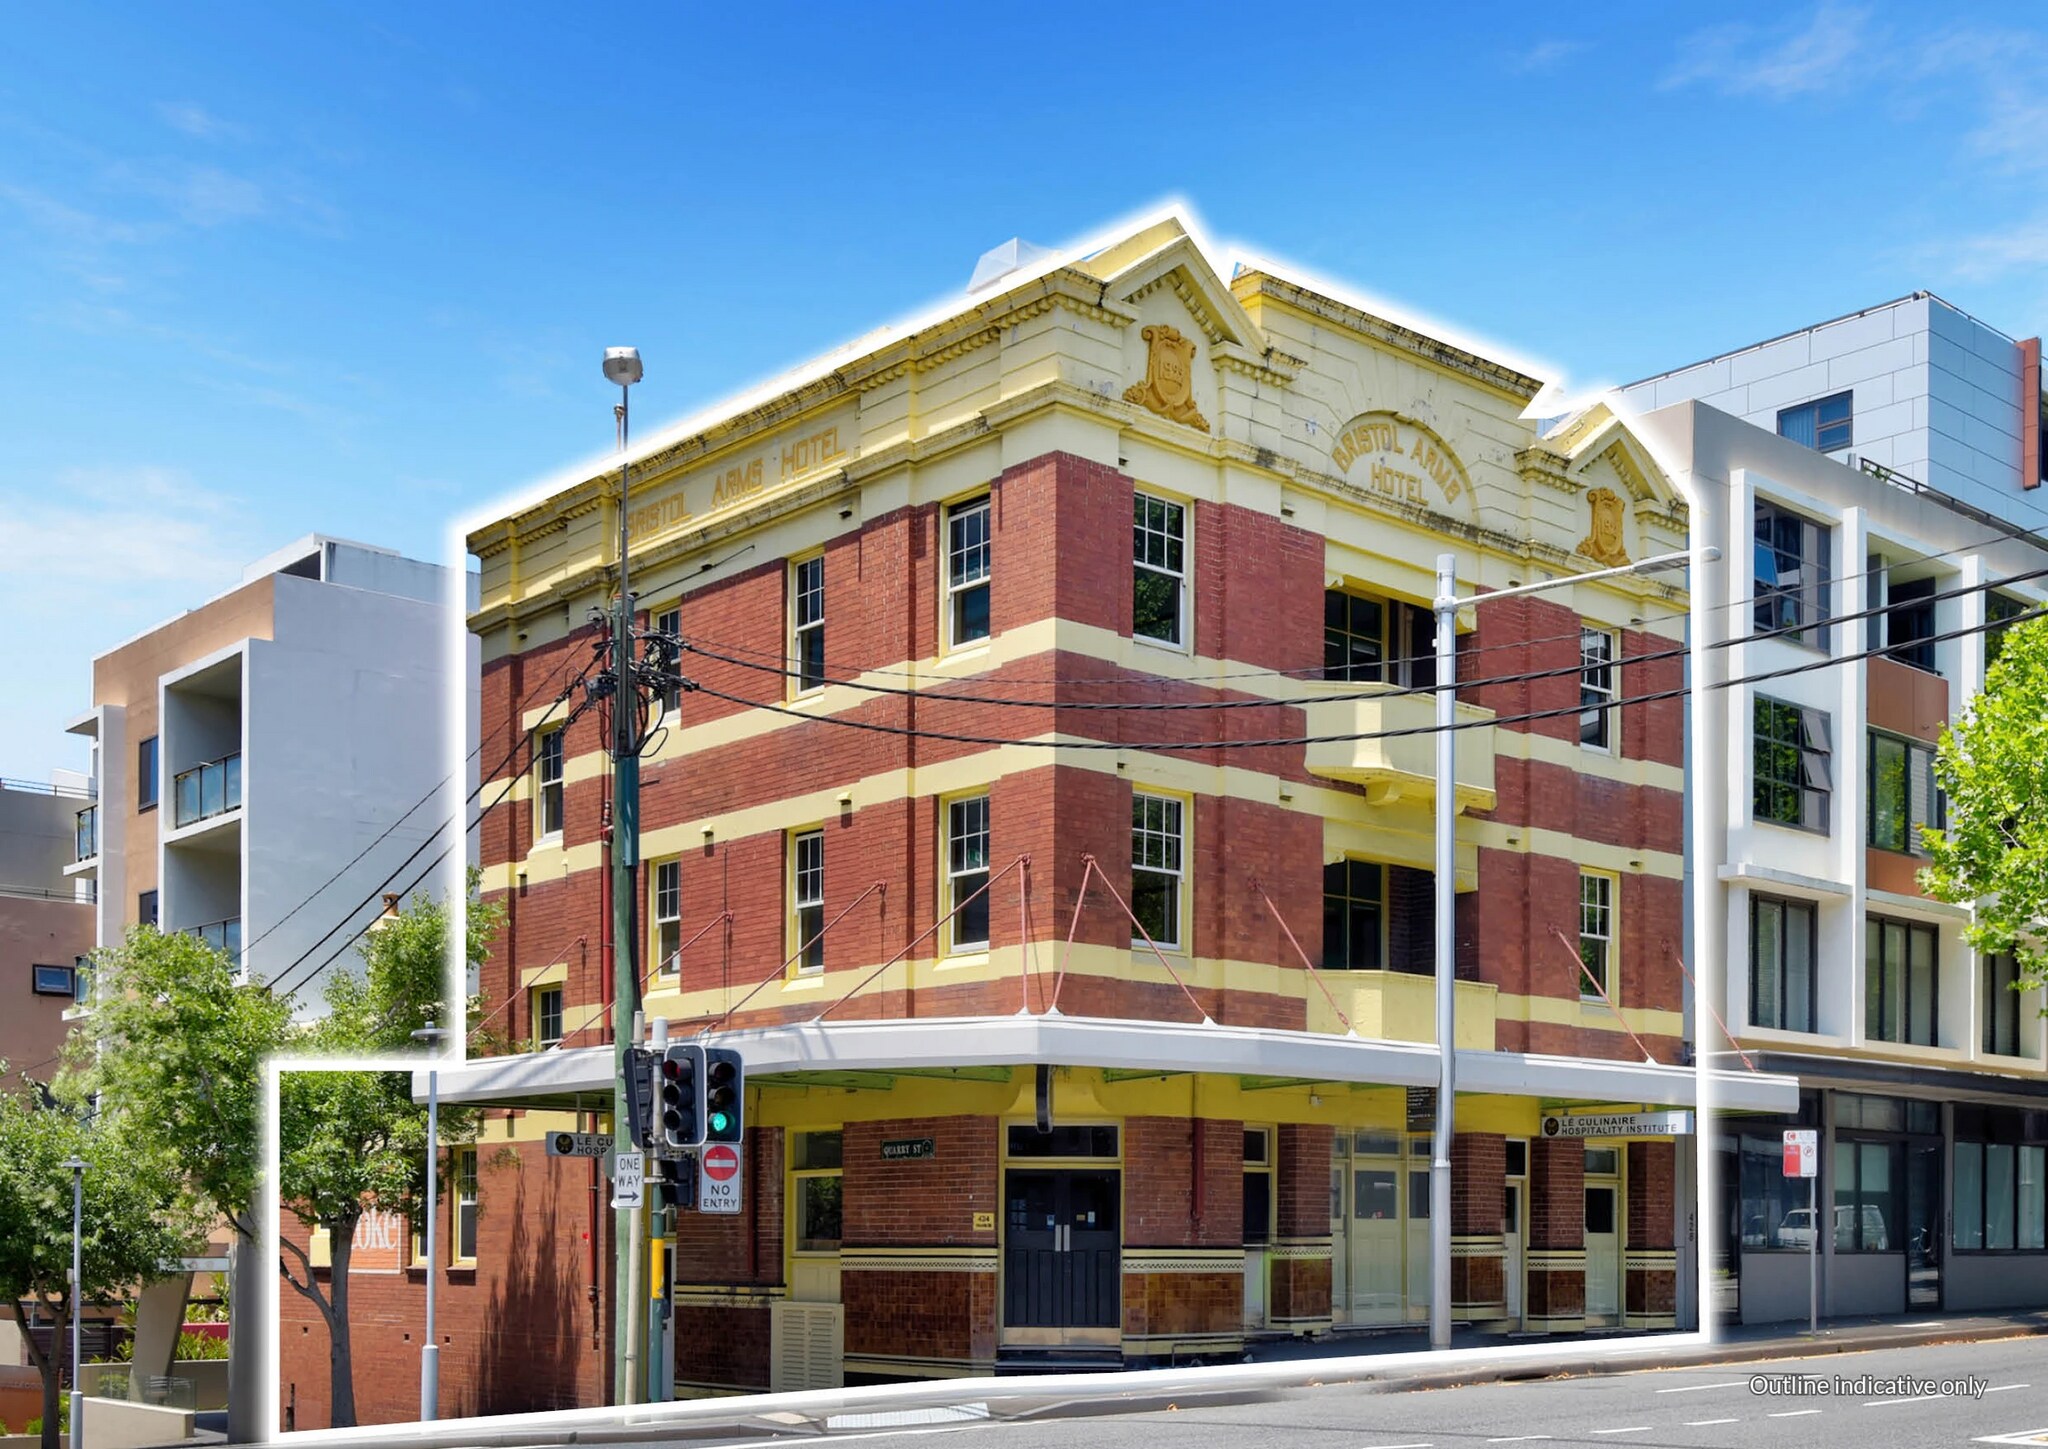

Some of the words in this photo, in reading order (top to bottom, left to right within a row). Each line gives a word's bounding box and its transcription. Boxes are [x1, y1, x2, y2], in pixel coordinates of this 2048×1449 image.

[1331, 423, 1404, 474] BRISTOL
[1410, 437, 1461, 505] ARMS
[627, 490, 692, 542] BRISTOL
[711, 457, 765, 508] ARMS
[781, 426, 847, 483] HOTEL
[1371, 462, 1429, 507] HOTEL
[1561, 1119, 1574, 1127] LE
[1578, 1116, 1637, 1127] CULINAIRE
[1561, 1126, 1623, 1136] HOSPITALITY
[1626, 1123, 1678, 1133] INSTITUTE
[577, 1137, 592, 1146] LE
[596, 1137, 614, 1147] CU
[577, 1146, 607, 1155] HOSP
[883, 1145, 910, 1156] QUARRY
[913, 1144, 922, 1154] ST
[619, 1158, 640, 1171] ONE
[618, 1175, 641, 1187] WAY
[711, 1185, 731, 1196] NO
[703, 1198, 737, 1208] ENTRY
